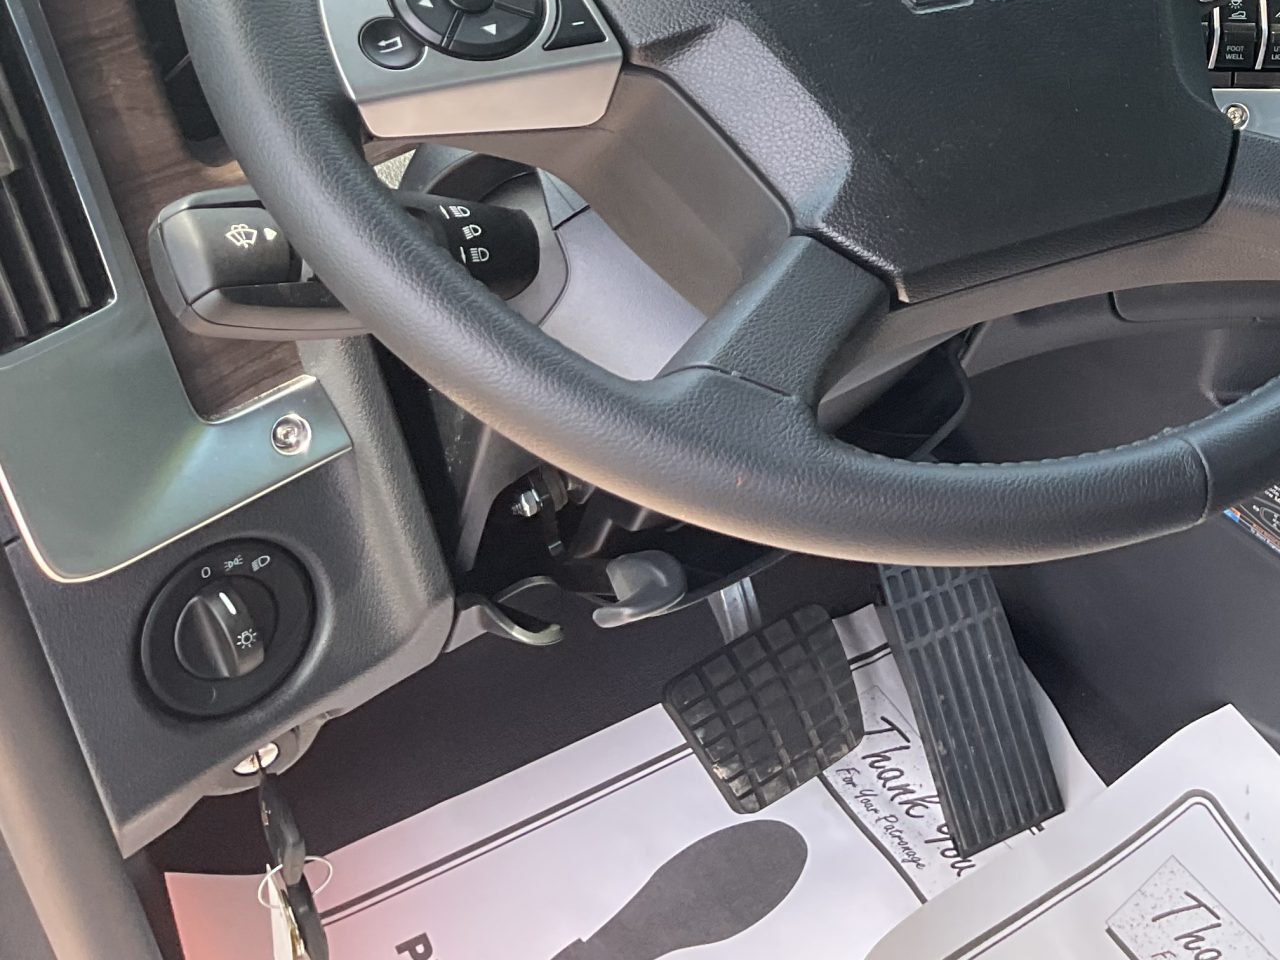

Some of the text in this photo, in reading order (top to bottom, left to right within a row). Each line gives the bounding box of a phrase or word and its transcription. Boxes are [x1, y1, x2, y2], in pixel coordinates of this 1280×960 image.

[836, 767, 926, 870] For Your Patronage
